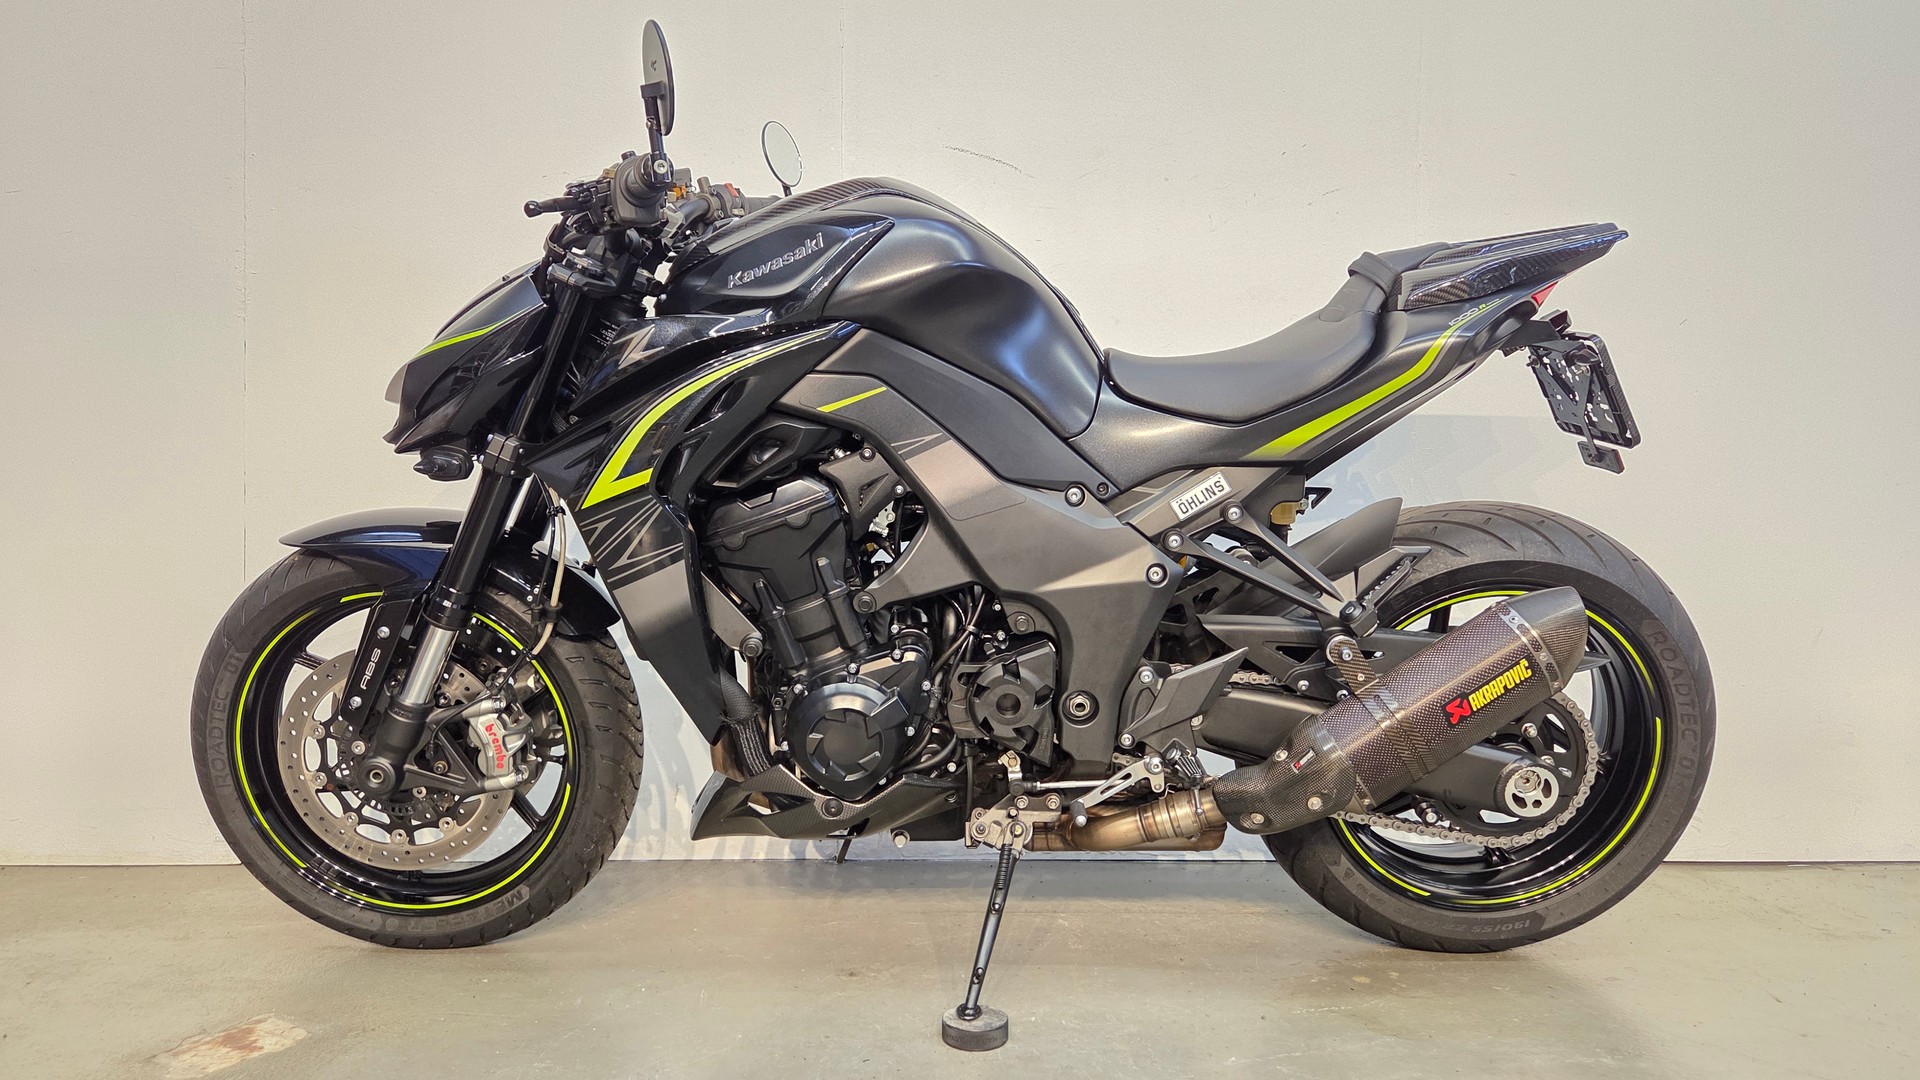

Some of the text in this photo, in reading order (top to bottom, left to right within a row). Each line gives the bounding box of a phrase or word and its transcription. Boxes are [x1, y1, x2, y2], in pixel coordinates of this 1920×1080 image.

[727, 232, 824, 289] Kawasaki
[1448, 307, 1479, 326] 1000
[1175, 479, 1225, 515] ÖHLINS
[360, 647, 381, 690] ABS
[1648, 630, 1698, 743] ROADTEC
[208, 686, 232, 789] ROADTEC
[485, 723, 507, 769] brembo
